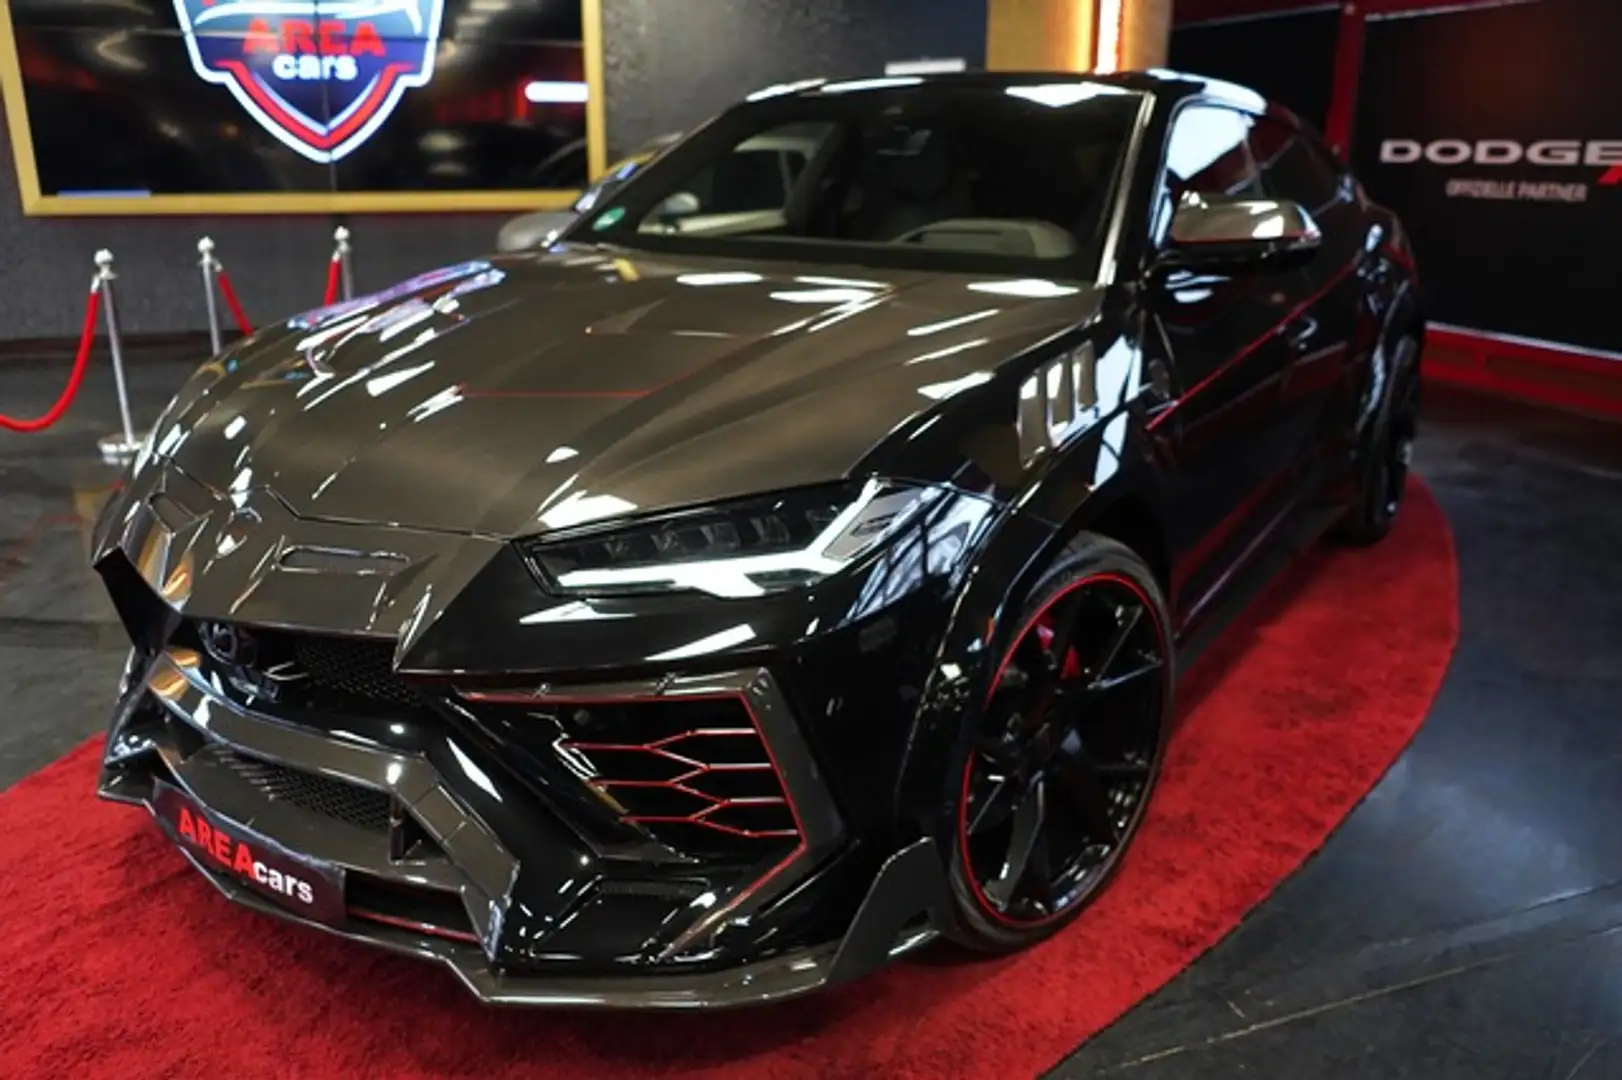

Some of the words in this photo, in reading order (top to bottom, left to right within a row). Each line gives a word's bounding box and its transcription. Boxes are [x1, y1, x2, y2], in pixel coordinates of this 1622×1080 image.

[242, 19, 386, 56] AREA
[272, 55, 358, 80] cars
[1380, 139, 1622, 166] DODGE
